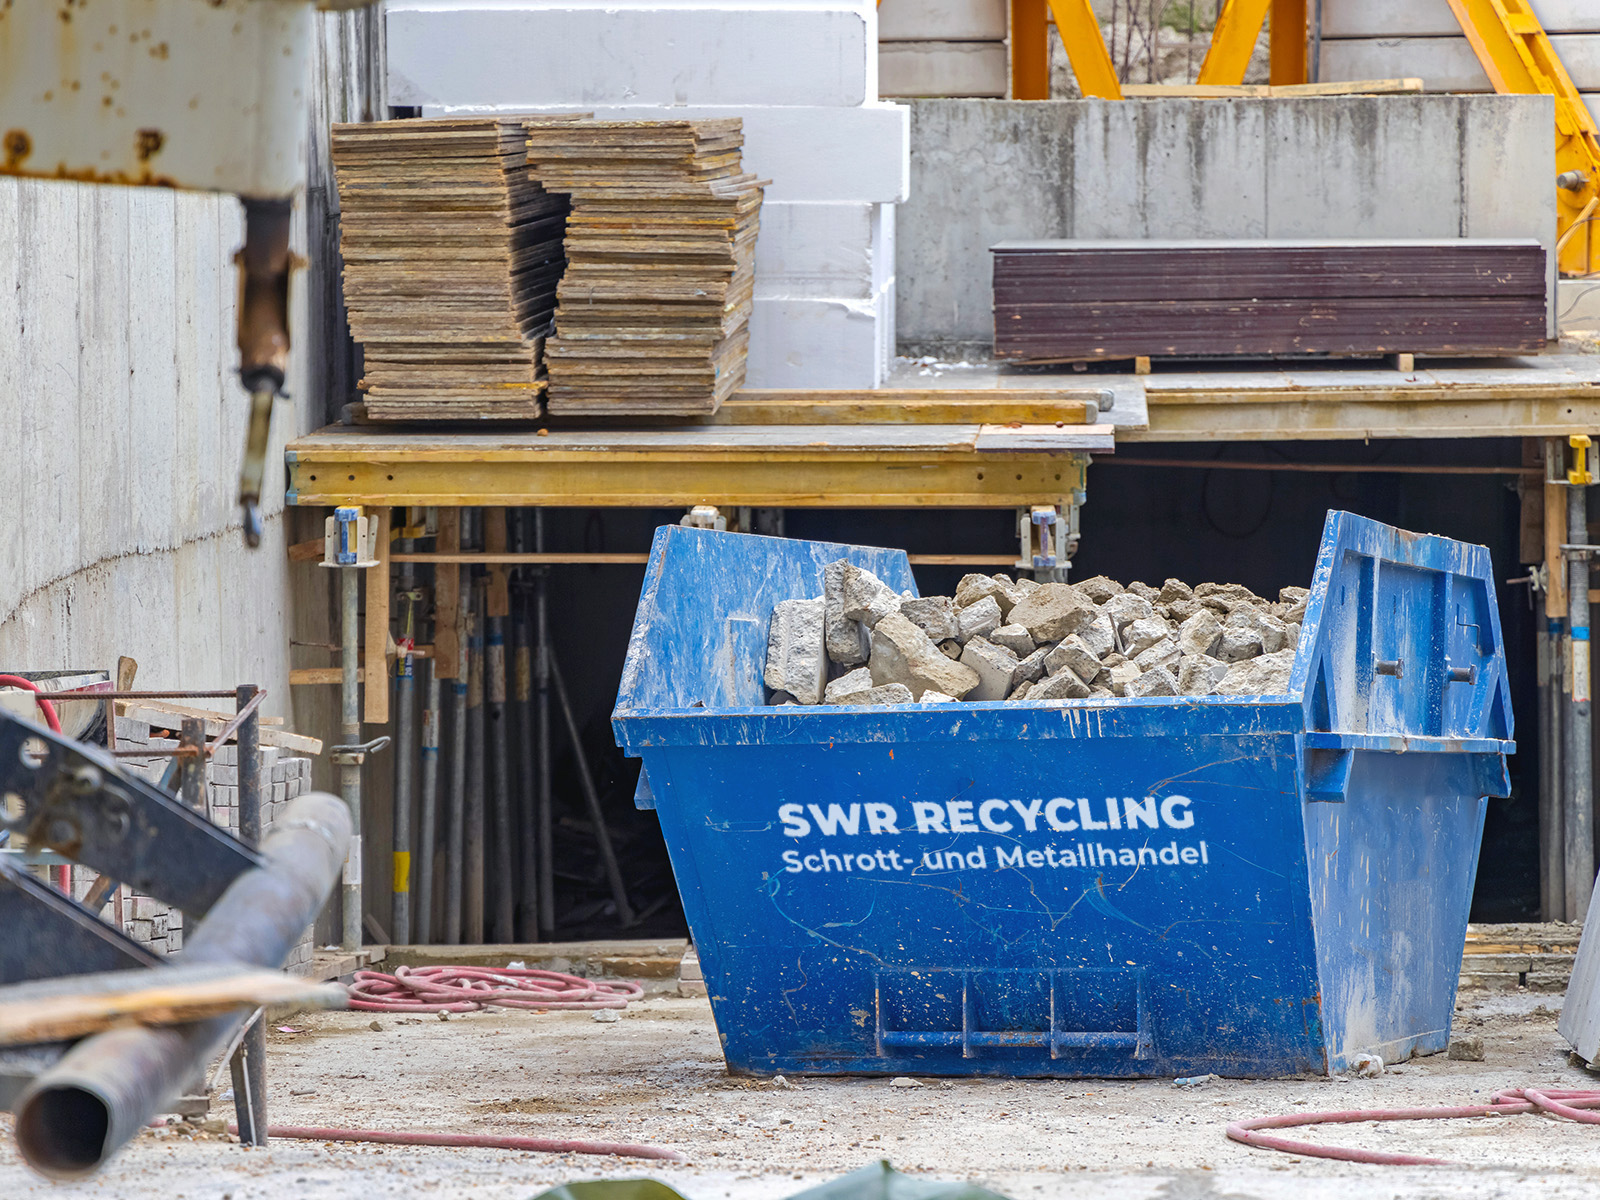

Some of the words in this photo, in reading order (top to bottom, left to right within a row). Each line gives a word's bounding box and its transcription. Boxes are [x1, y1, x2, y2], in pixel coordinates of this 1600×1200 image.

[778, 802, 901, 838] SWR
[911, 795, 1195, 835] RECYCLING
[781, 849, 914, 873] Schrott-
[922, 846, 987, 870] und
[995, 841, 1209, 869] Metallhandel
